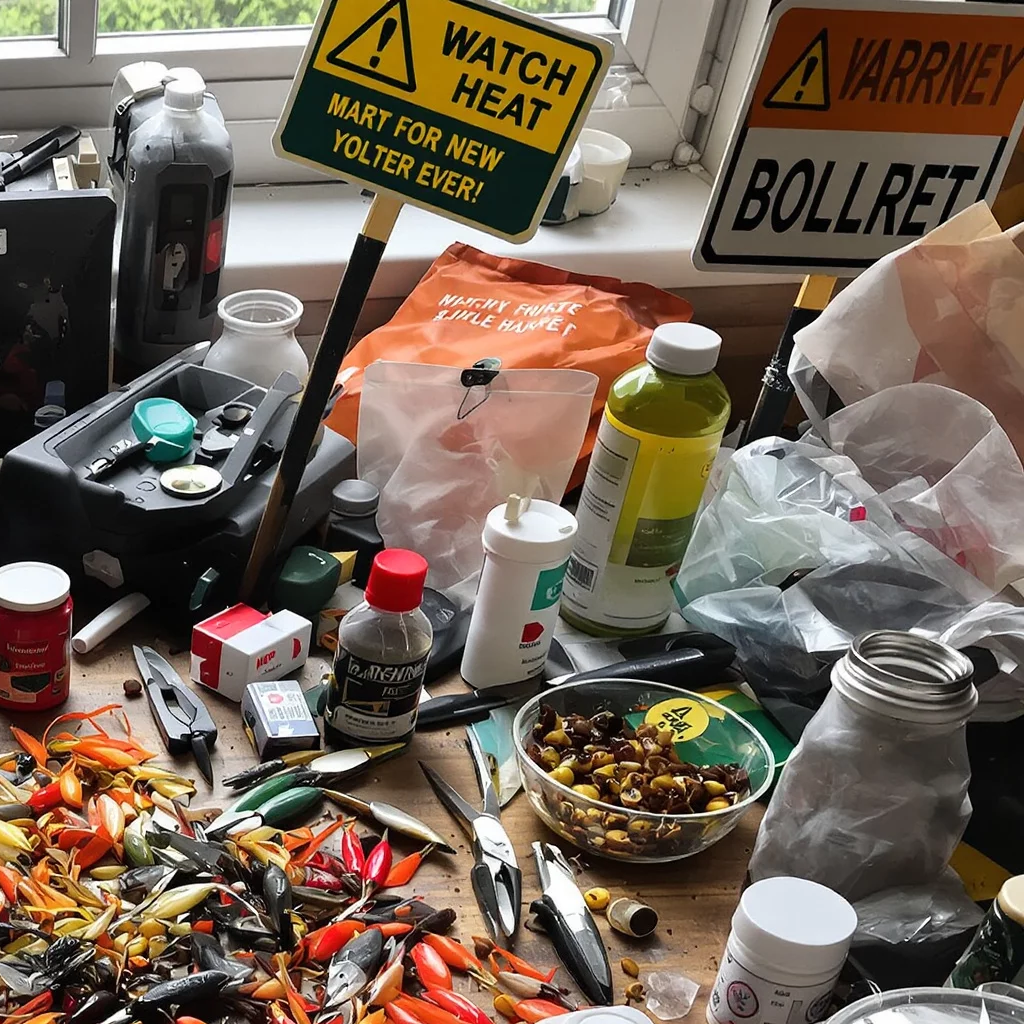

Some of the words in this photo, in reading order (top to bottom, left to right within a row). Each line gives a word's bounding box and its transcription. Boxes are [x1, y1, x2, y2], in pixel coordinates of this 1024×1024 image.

[441, 21, 577, 96] WATCH
[838, 37, 1024, 106] VARRNEY
[327, 92, 392, 132] MART
[393, 115, 443, 152] FOR
[444, 133, 505, 172] NEW
[451, 73, 553, 131] HEAT
[332, 129, 415, 180] YOLTER
[415, 161, 485, 203] EVER!
[731, 158, 980, 236] BOLLRET
